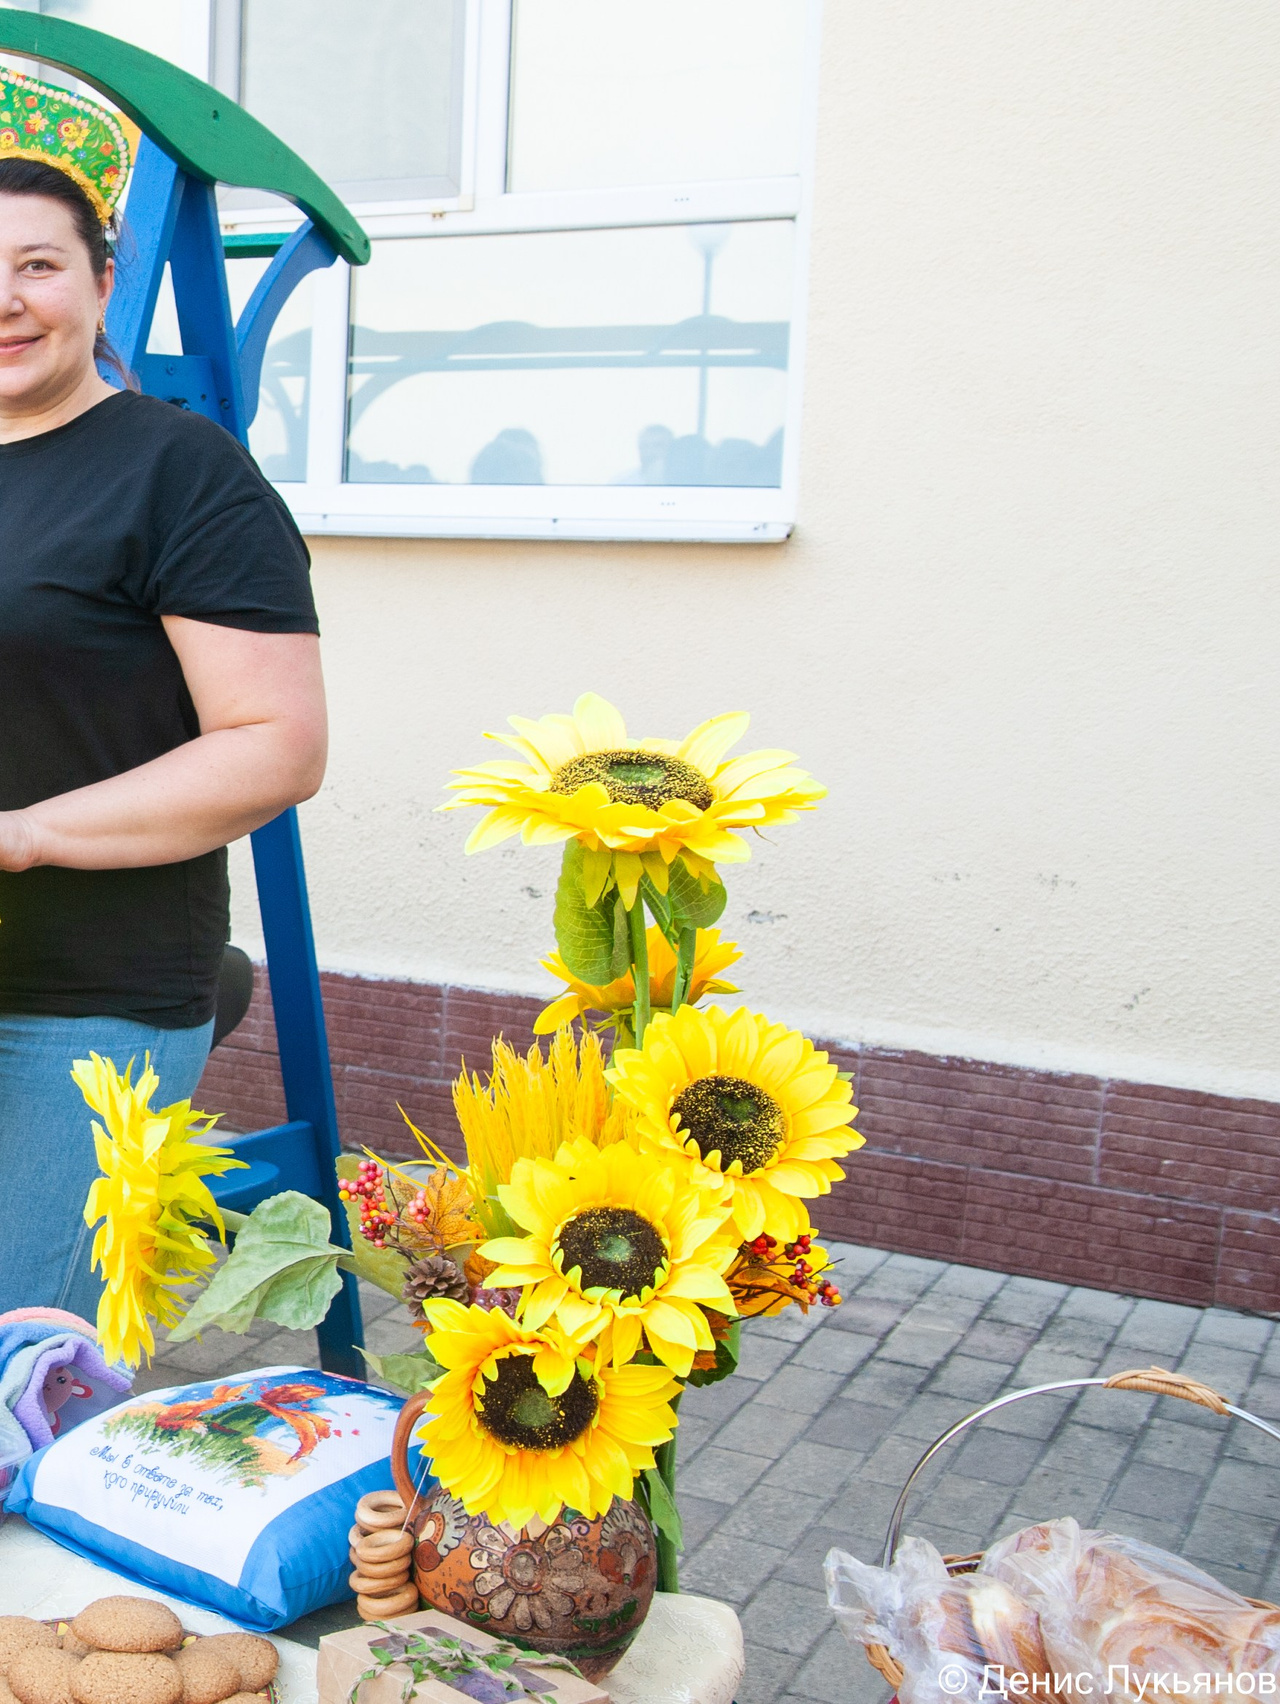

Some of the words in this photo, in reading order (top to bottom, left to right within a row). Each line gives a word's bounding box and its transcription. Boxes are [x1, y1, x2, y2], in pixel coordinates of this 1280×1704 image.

[89, 1445, 119, 1463] Мы
[133, 1464, 177, 1488] ответе
[104, 1470, 127, 1489] кого
[130, 1481, 190, 1515] приручили
